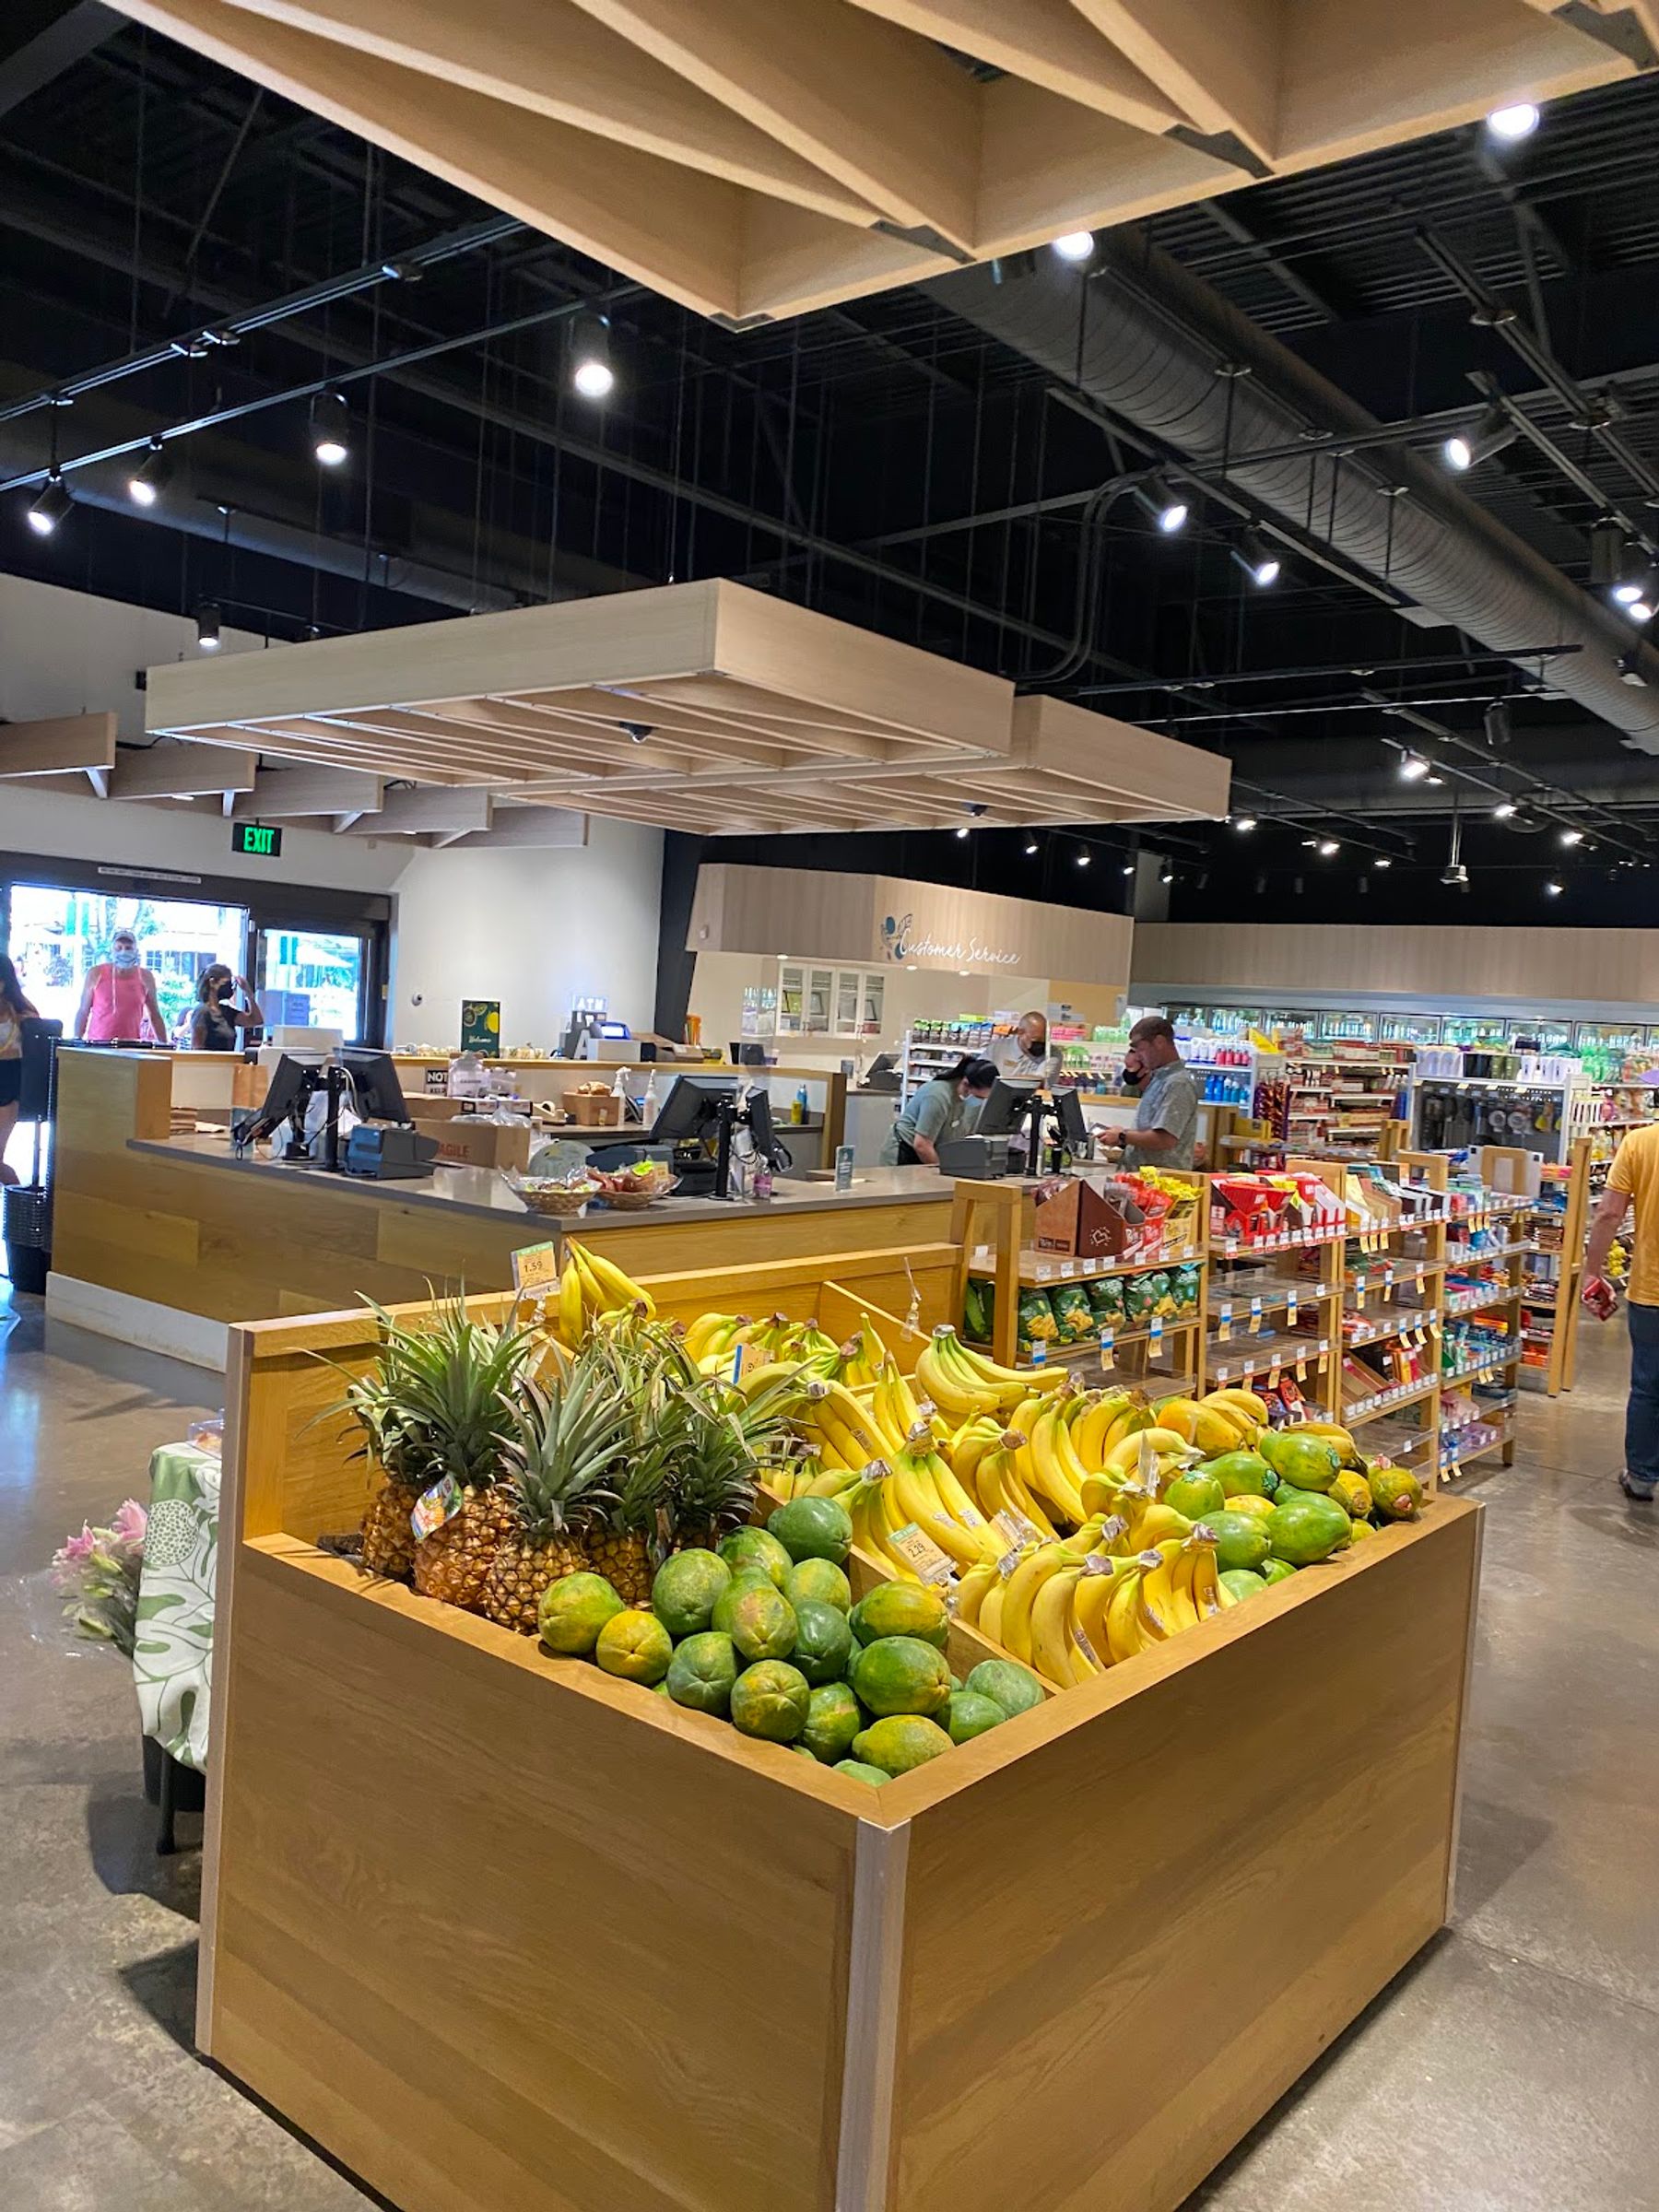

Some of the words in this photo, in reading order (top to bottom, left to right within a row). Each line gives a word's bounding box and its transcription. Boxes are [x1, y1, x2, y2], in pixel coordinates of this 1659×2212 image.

[244, 827, 275, 853] EXIT
[900, 928, 966, 959] Customer
[966, 936, 1020, 964] Service
[576, 997, 606, 1011] ATM
[427, 1071, 448, 1083] NOT
[438, 1142, 470, 1159] AGILE
[524, 1260, 543, 1273] 1.59
